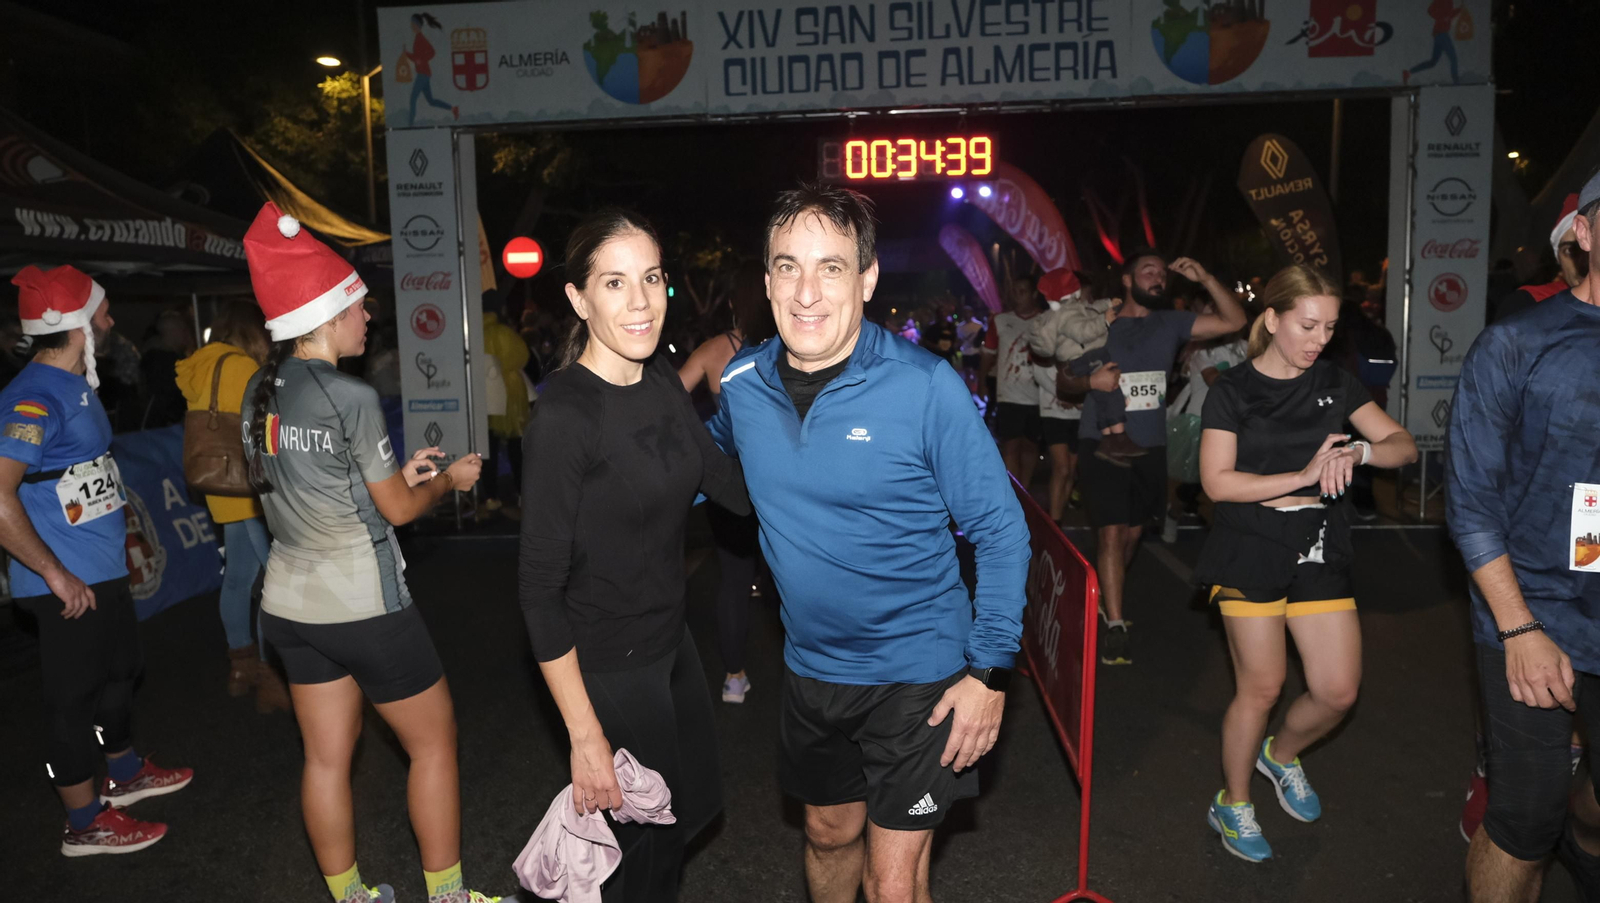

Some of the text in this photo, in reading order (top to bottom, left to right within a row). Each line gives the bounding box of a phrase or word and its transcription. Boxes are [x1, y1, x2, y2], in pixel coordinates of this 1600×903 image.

[717, 0, 1110, 50] XIV SAN SILVESTRE
[498, 48, 571, 68] ALMERÍA
[723, 32, 1118, 97] CIUDAD DE ALMERÍA
[516, 67, 555, 78] CIUDAD
[1427, 142, 1481, 151] RENAULT
[396, 182, 443, 191] RENAULT
[1427, 193, 1477, 201] NISSAN
[400, 229, 445, 237] NISSAN
[1130, 384, 1158, 397] 855
[1415, 434, 1445, 443] RENA
[79, 472, 115, 499] 124
[172, 512, 217, 550] DE
[908, 804, 938, 816] adidas
